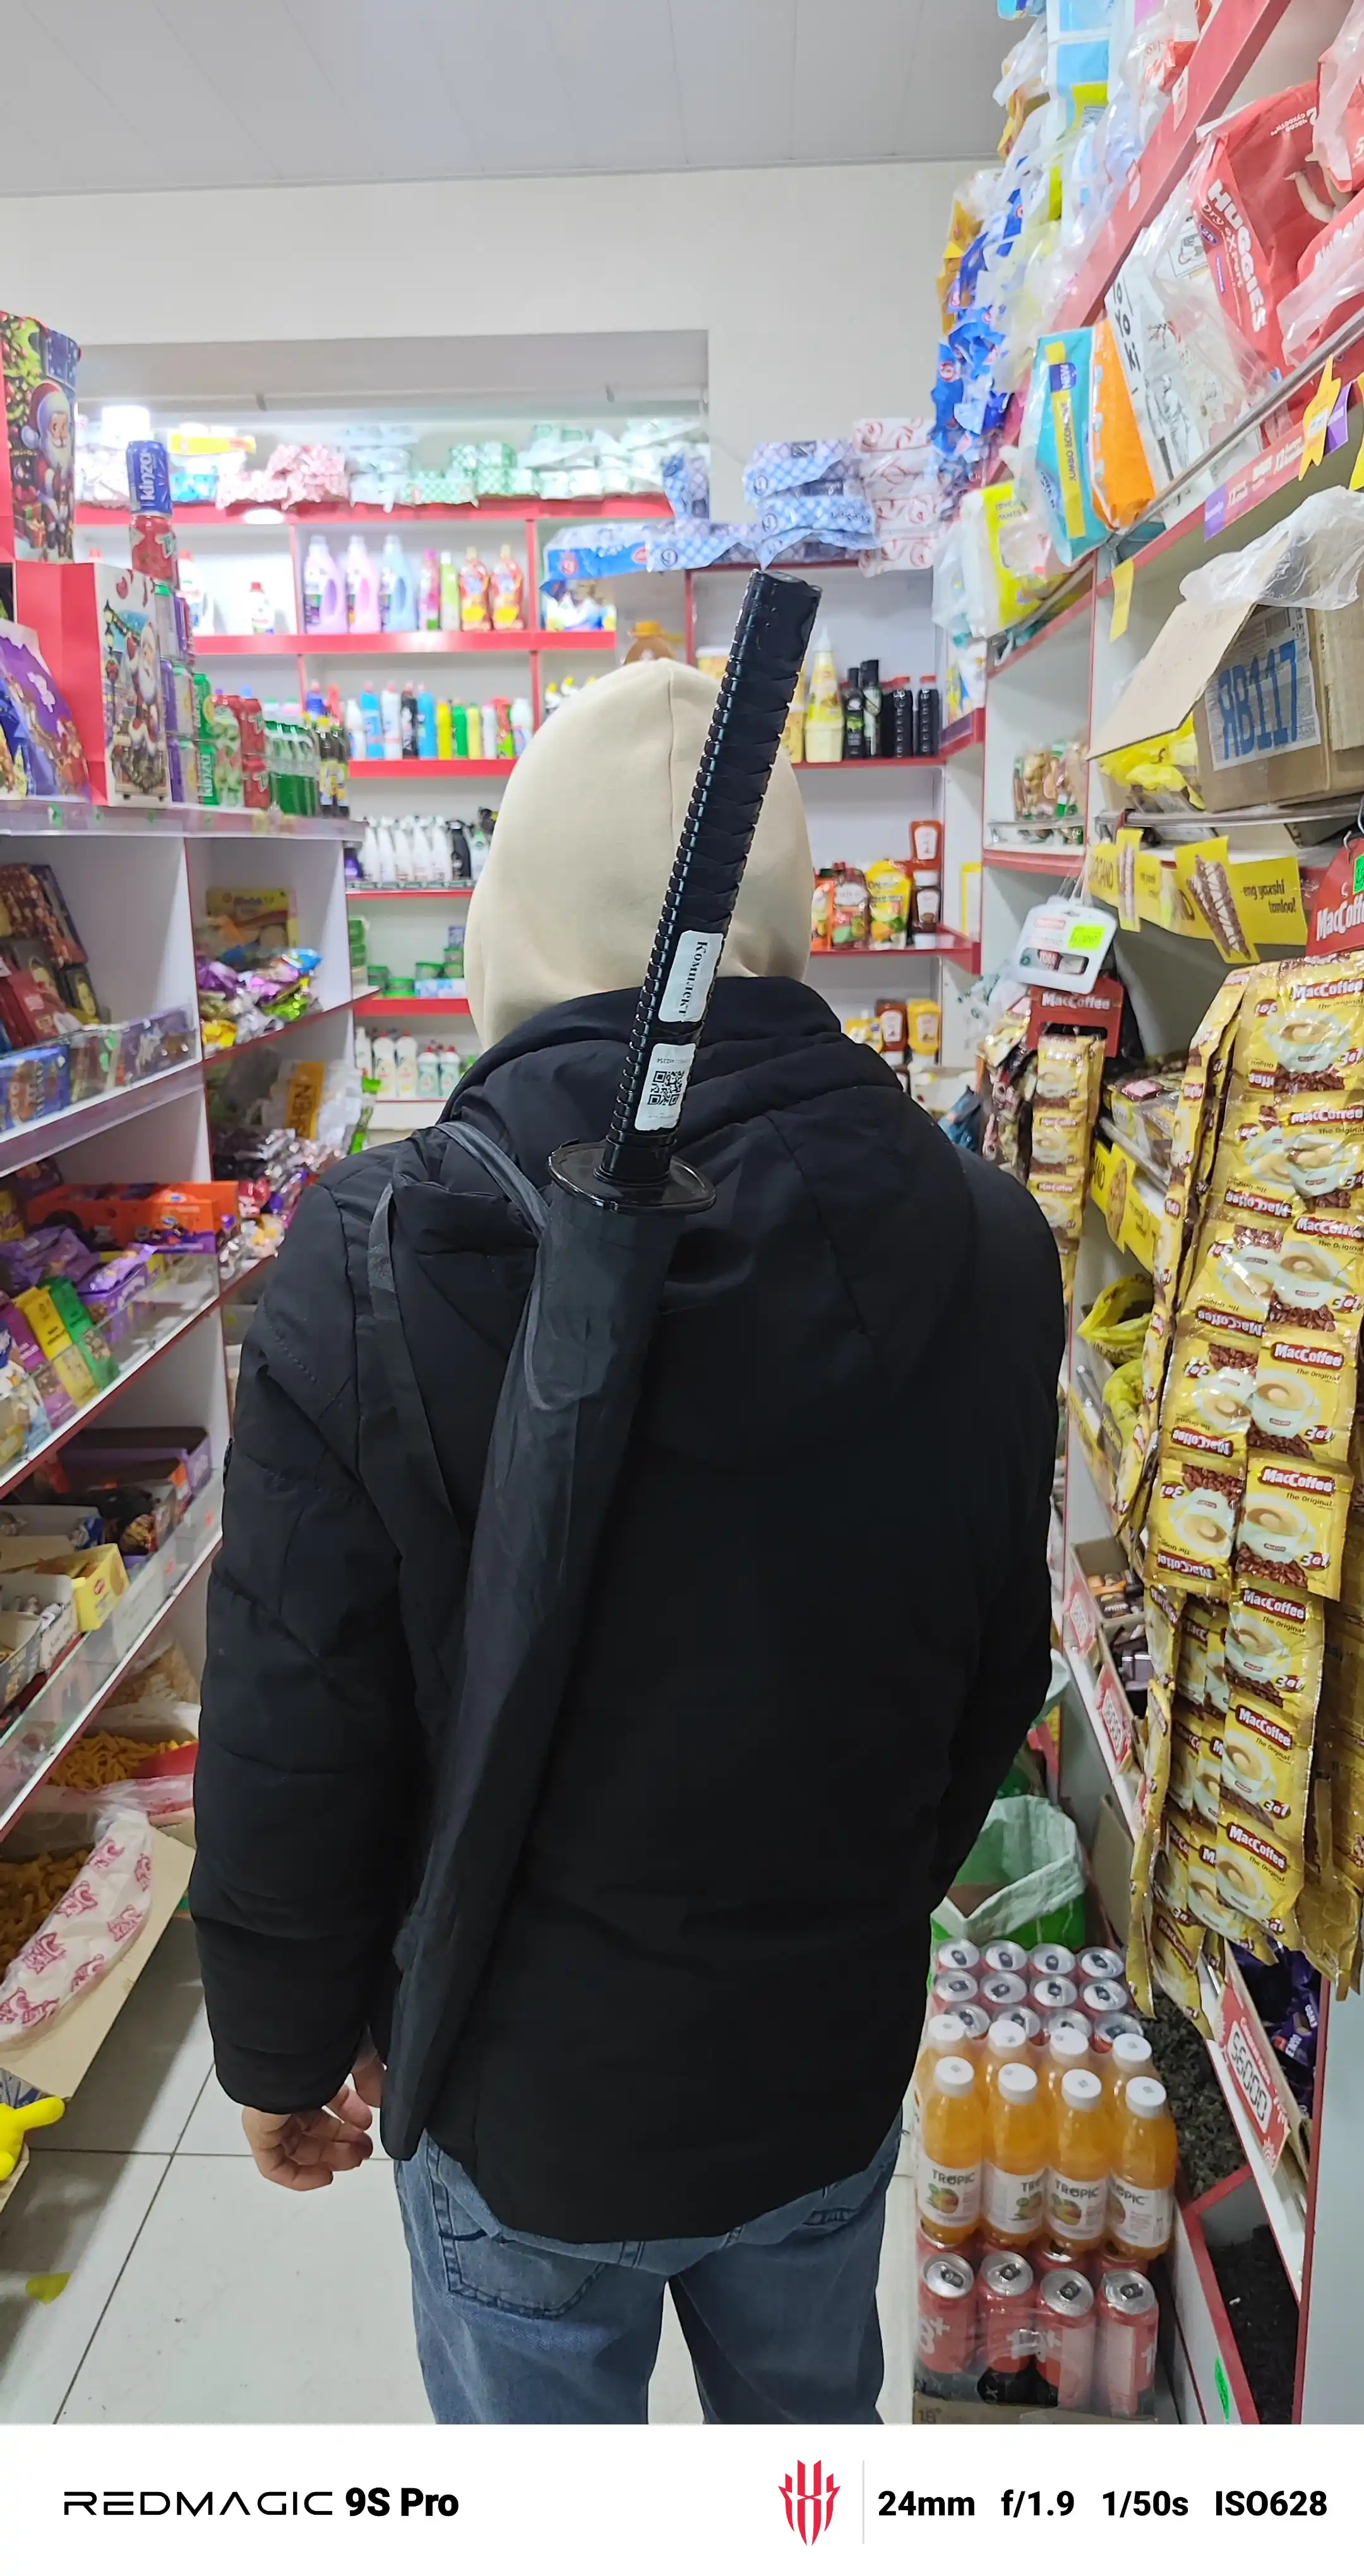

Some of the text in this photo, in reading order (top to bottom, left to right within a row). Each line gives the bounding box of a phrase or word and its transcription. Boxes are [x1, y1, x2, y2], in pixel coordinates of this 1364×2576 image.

[1202, 203, 1224, 225] Dry
[1207, 178, 1267, 333] HUGGIES
[1060, 364, 1072, 390] NEW
[1066, 450, 1077, 482] JUMBO
[1242, 885, 1257, 900] eng
[1316, 893, 1364, 941] MacCoff
[678, 941, 709, 1015] Комплект
[1291, 978, 1363, 1000] MacCoffee
[1043, 991, 1111, 1010] MacCoffee
[1291, 1107, 1363, 1124] MacCoffee
[1226, 1191, 1291, 1217] MacCoffee
[1197, 1309, 1262, 1337] MacCoffee
[1274, 1343, 1343, 1368] MacCoffee
[1295, 1368, 1310, 1376] The
[1173, 1429, 1231, 1455] MacCoffee
[1262, 1468, 1334, 1493] MacCoffee
[1286, 1492, 1333, 1508] The Original
[1243, 1589, 1305, 1620] MacCoffee
[1262, 1616, 1306, 1634] The Original
[1238, 1707, 1291, 1748] MacCoffee
[1255, 1737, 1267, 1748] The
[1229, 1824, 1285, 1869] MacCoffee
[1249, 1856, 1260, 1866] The
[1230, 2030, 1268, 2122] 56000
[931, 2169, 976, 2185] TROPIC
[1055, 2179, 1100, 2199] TROPIC
